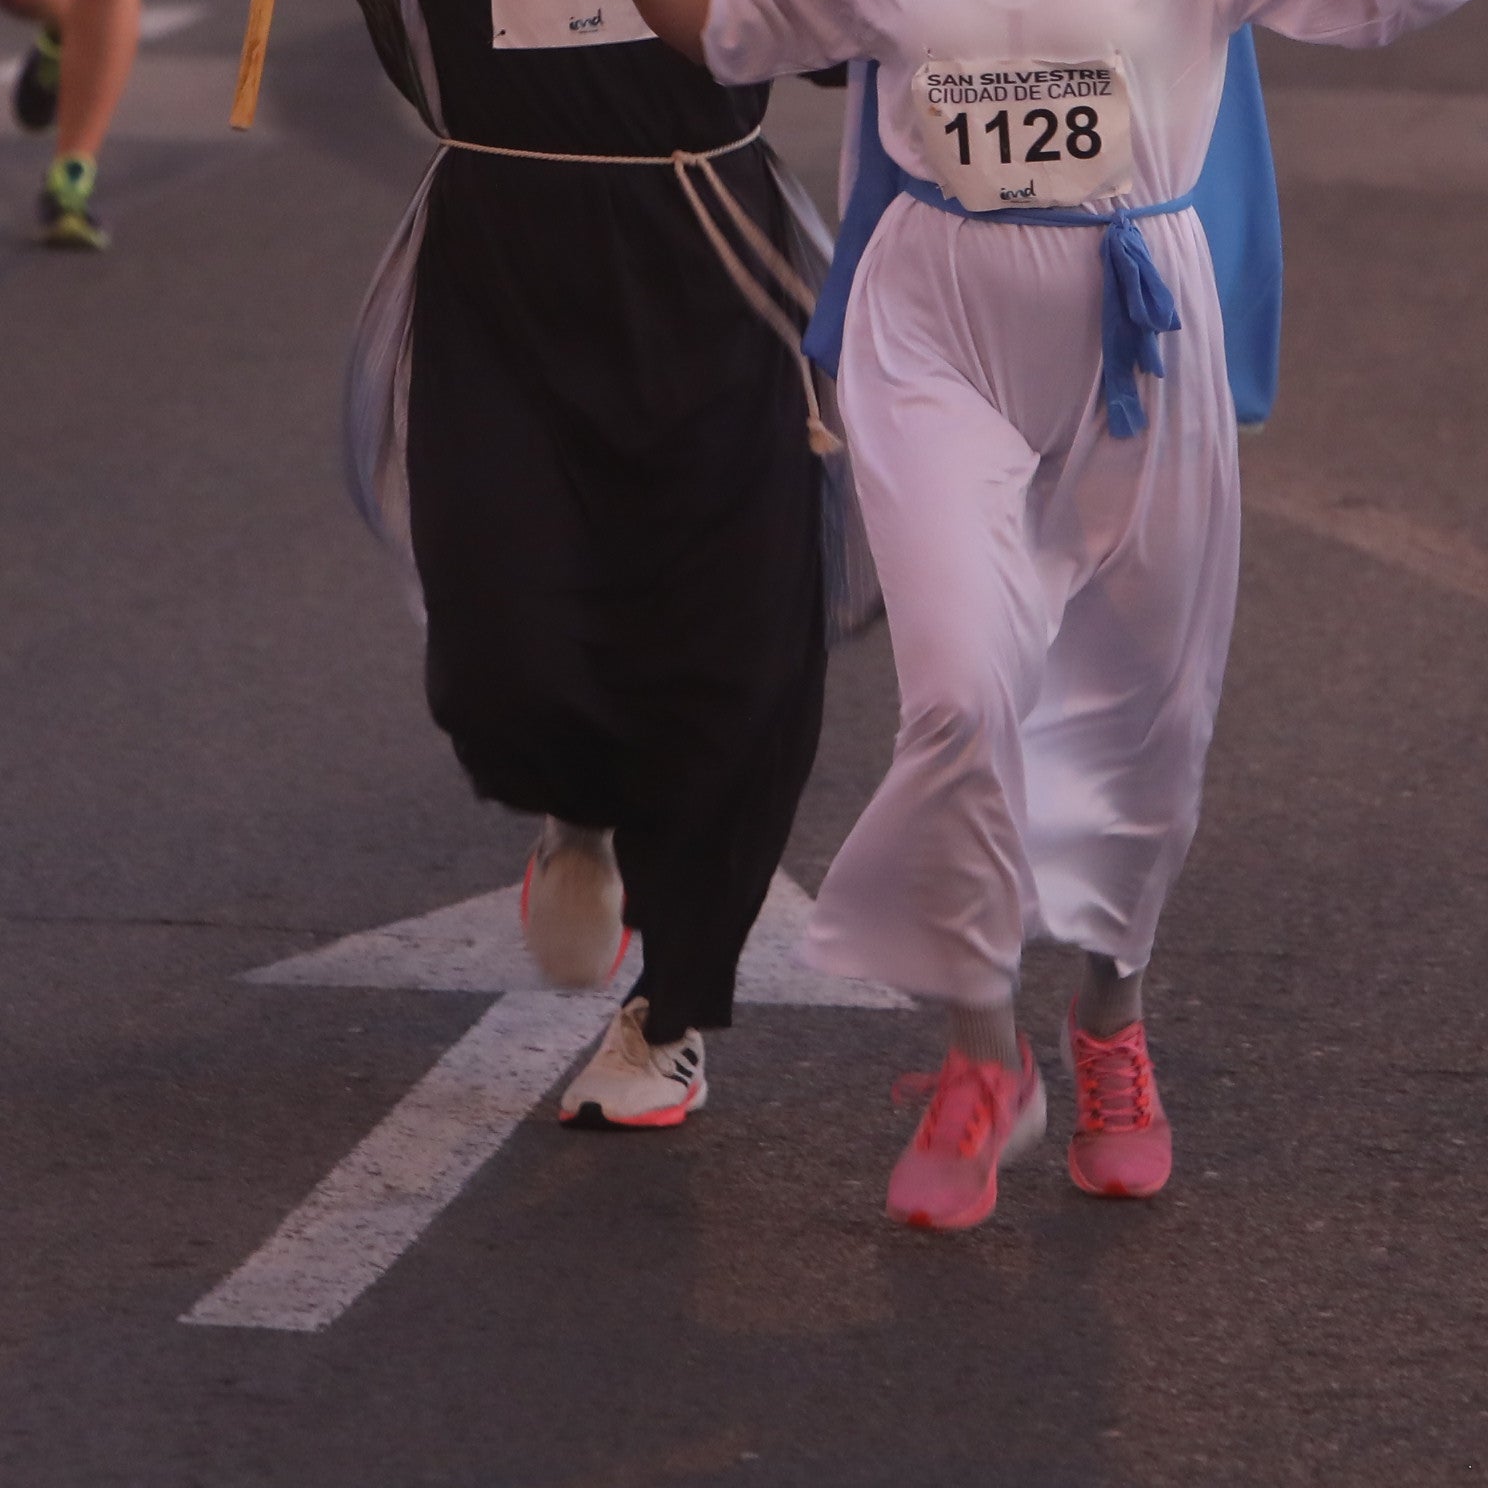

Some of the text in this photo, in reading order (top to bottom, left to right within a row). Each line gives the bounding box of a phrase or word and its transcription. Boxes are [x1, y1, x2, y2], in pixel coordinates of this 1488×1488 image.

[927, 69, 1112, 87] SAN SILVESTRE
[928, 81, 1112, 104] CIUDAD DE CADIZ
[944, 105, 1102, 166] 1128
